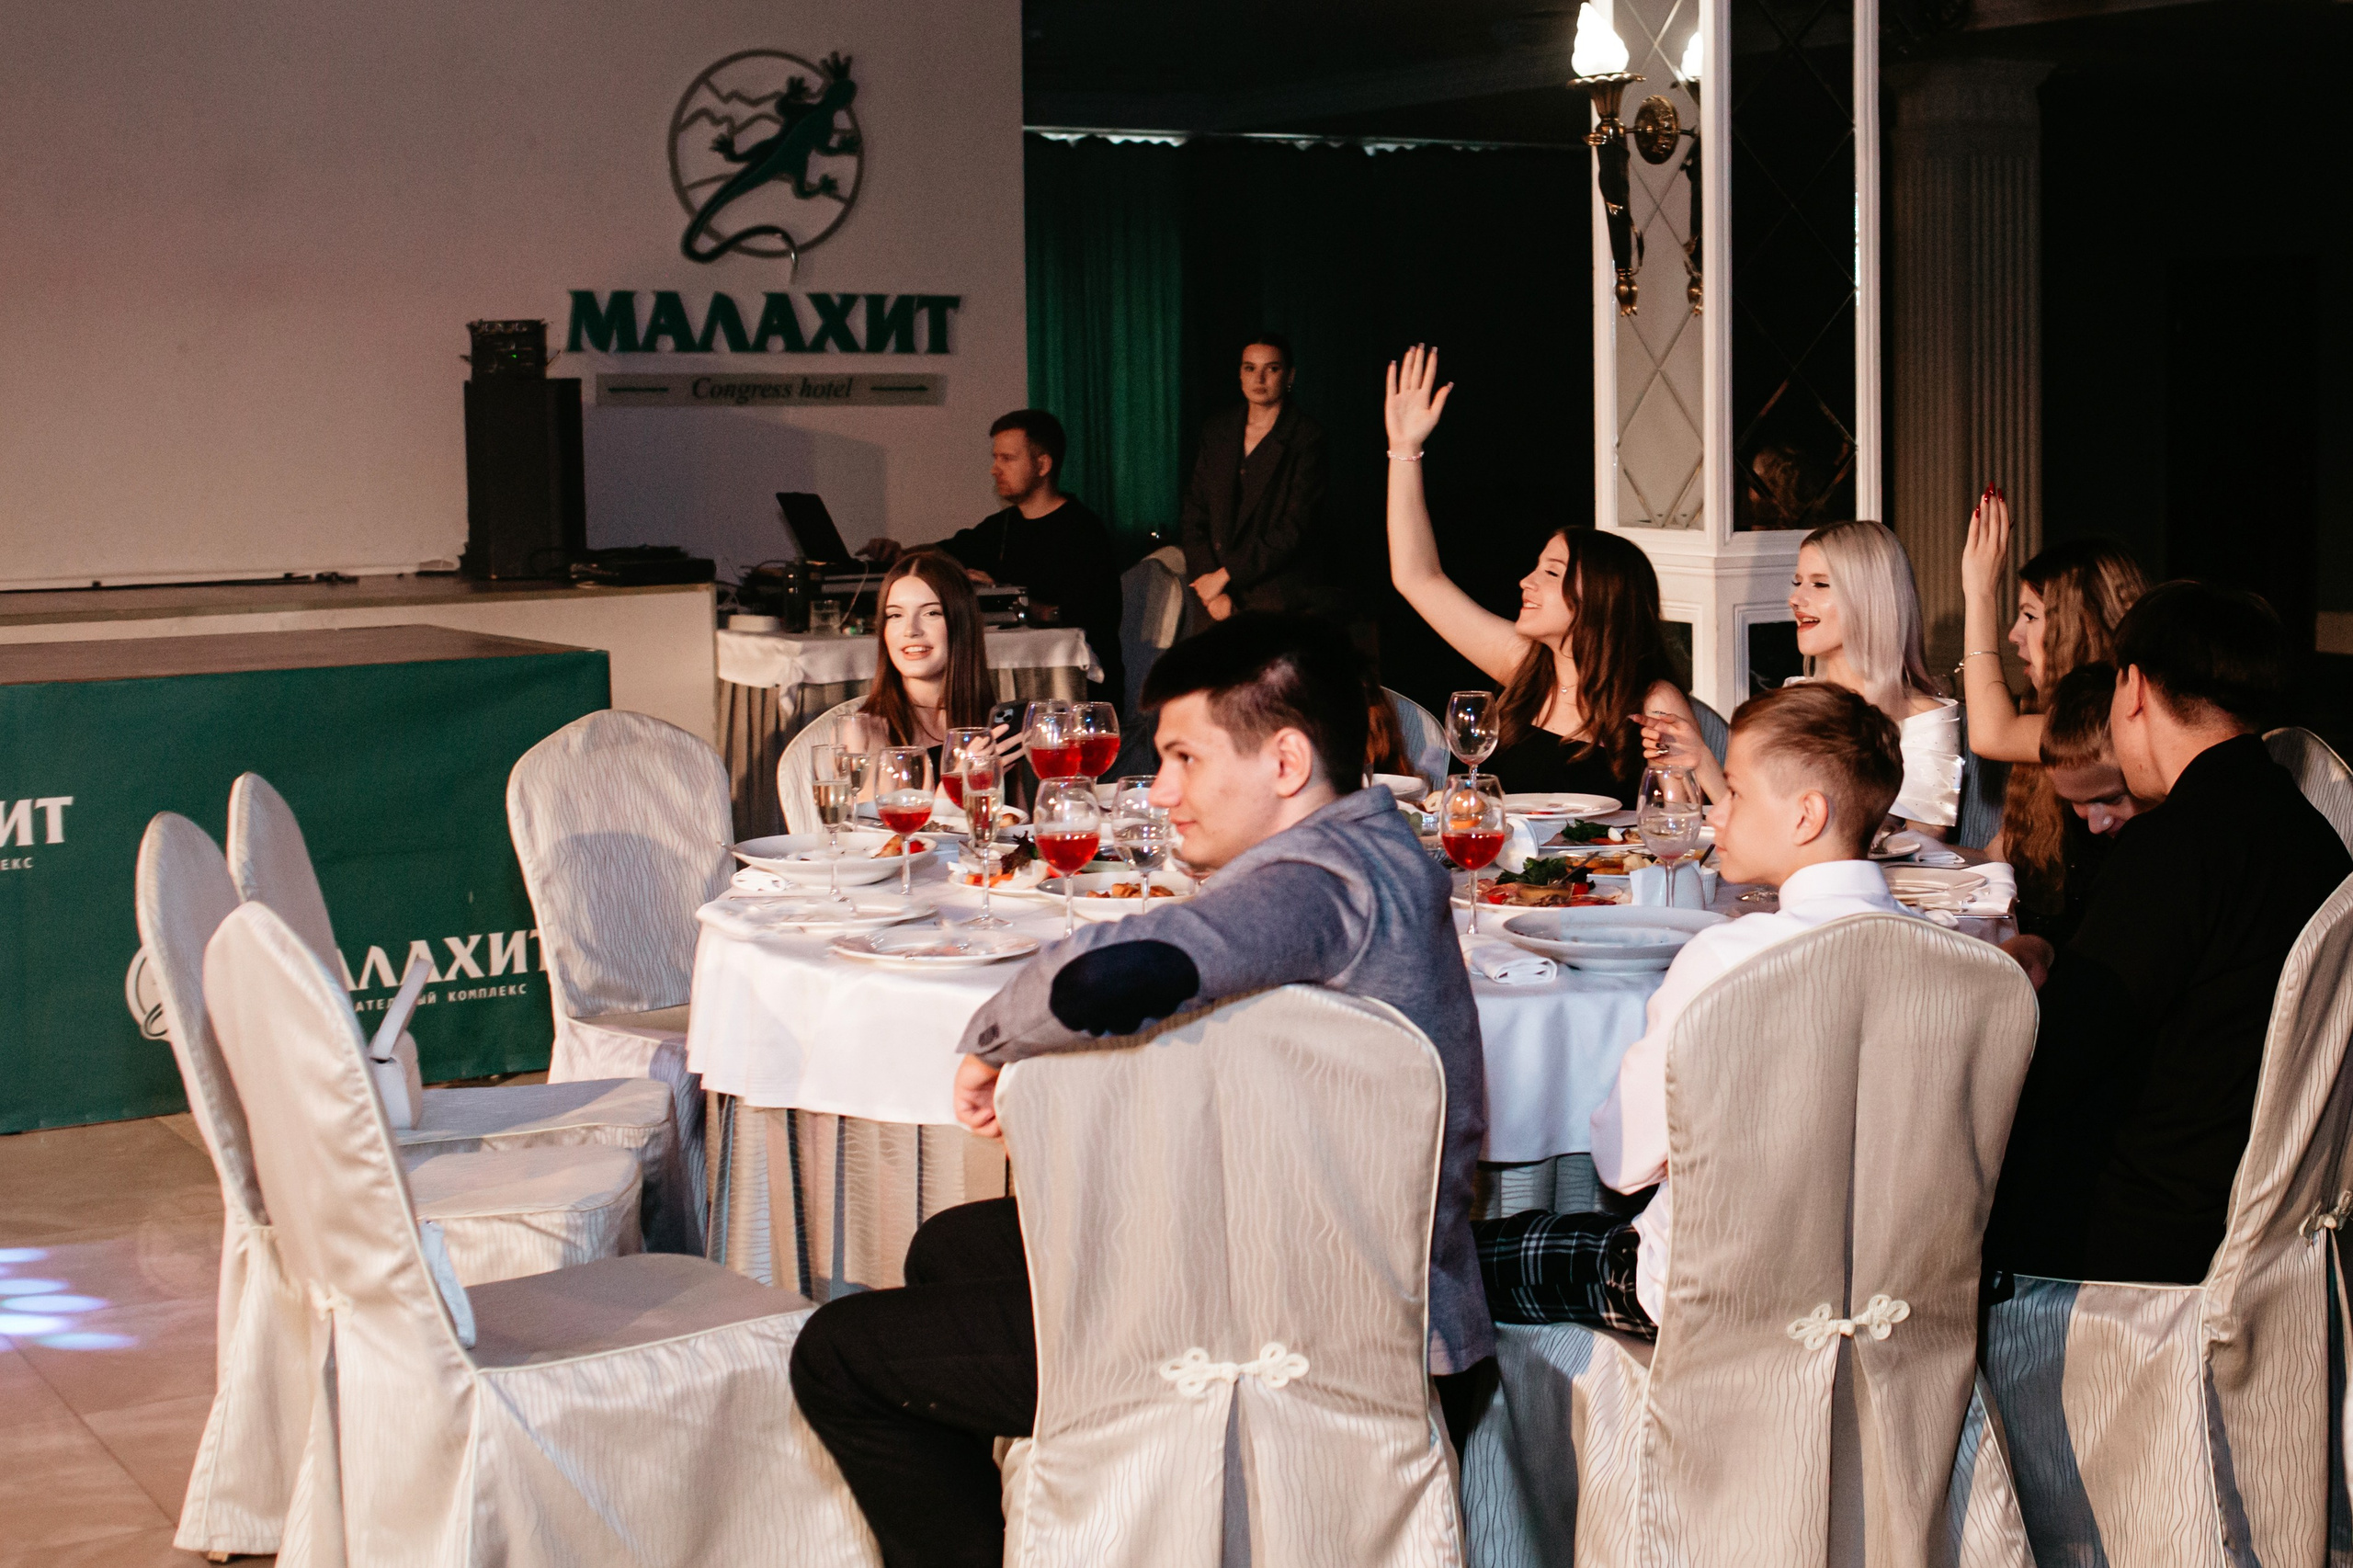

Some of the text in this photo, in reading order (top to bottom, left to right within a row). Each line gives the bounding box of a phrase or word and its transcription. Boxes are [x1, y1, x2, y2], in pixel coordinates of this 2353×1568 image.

[567, 290, 961, 355] МАЛАХИТ
[692, 377, 853, 404] Congress hotel
[448, 983, 527, 1003] КОМПЛЕКС
